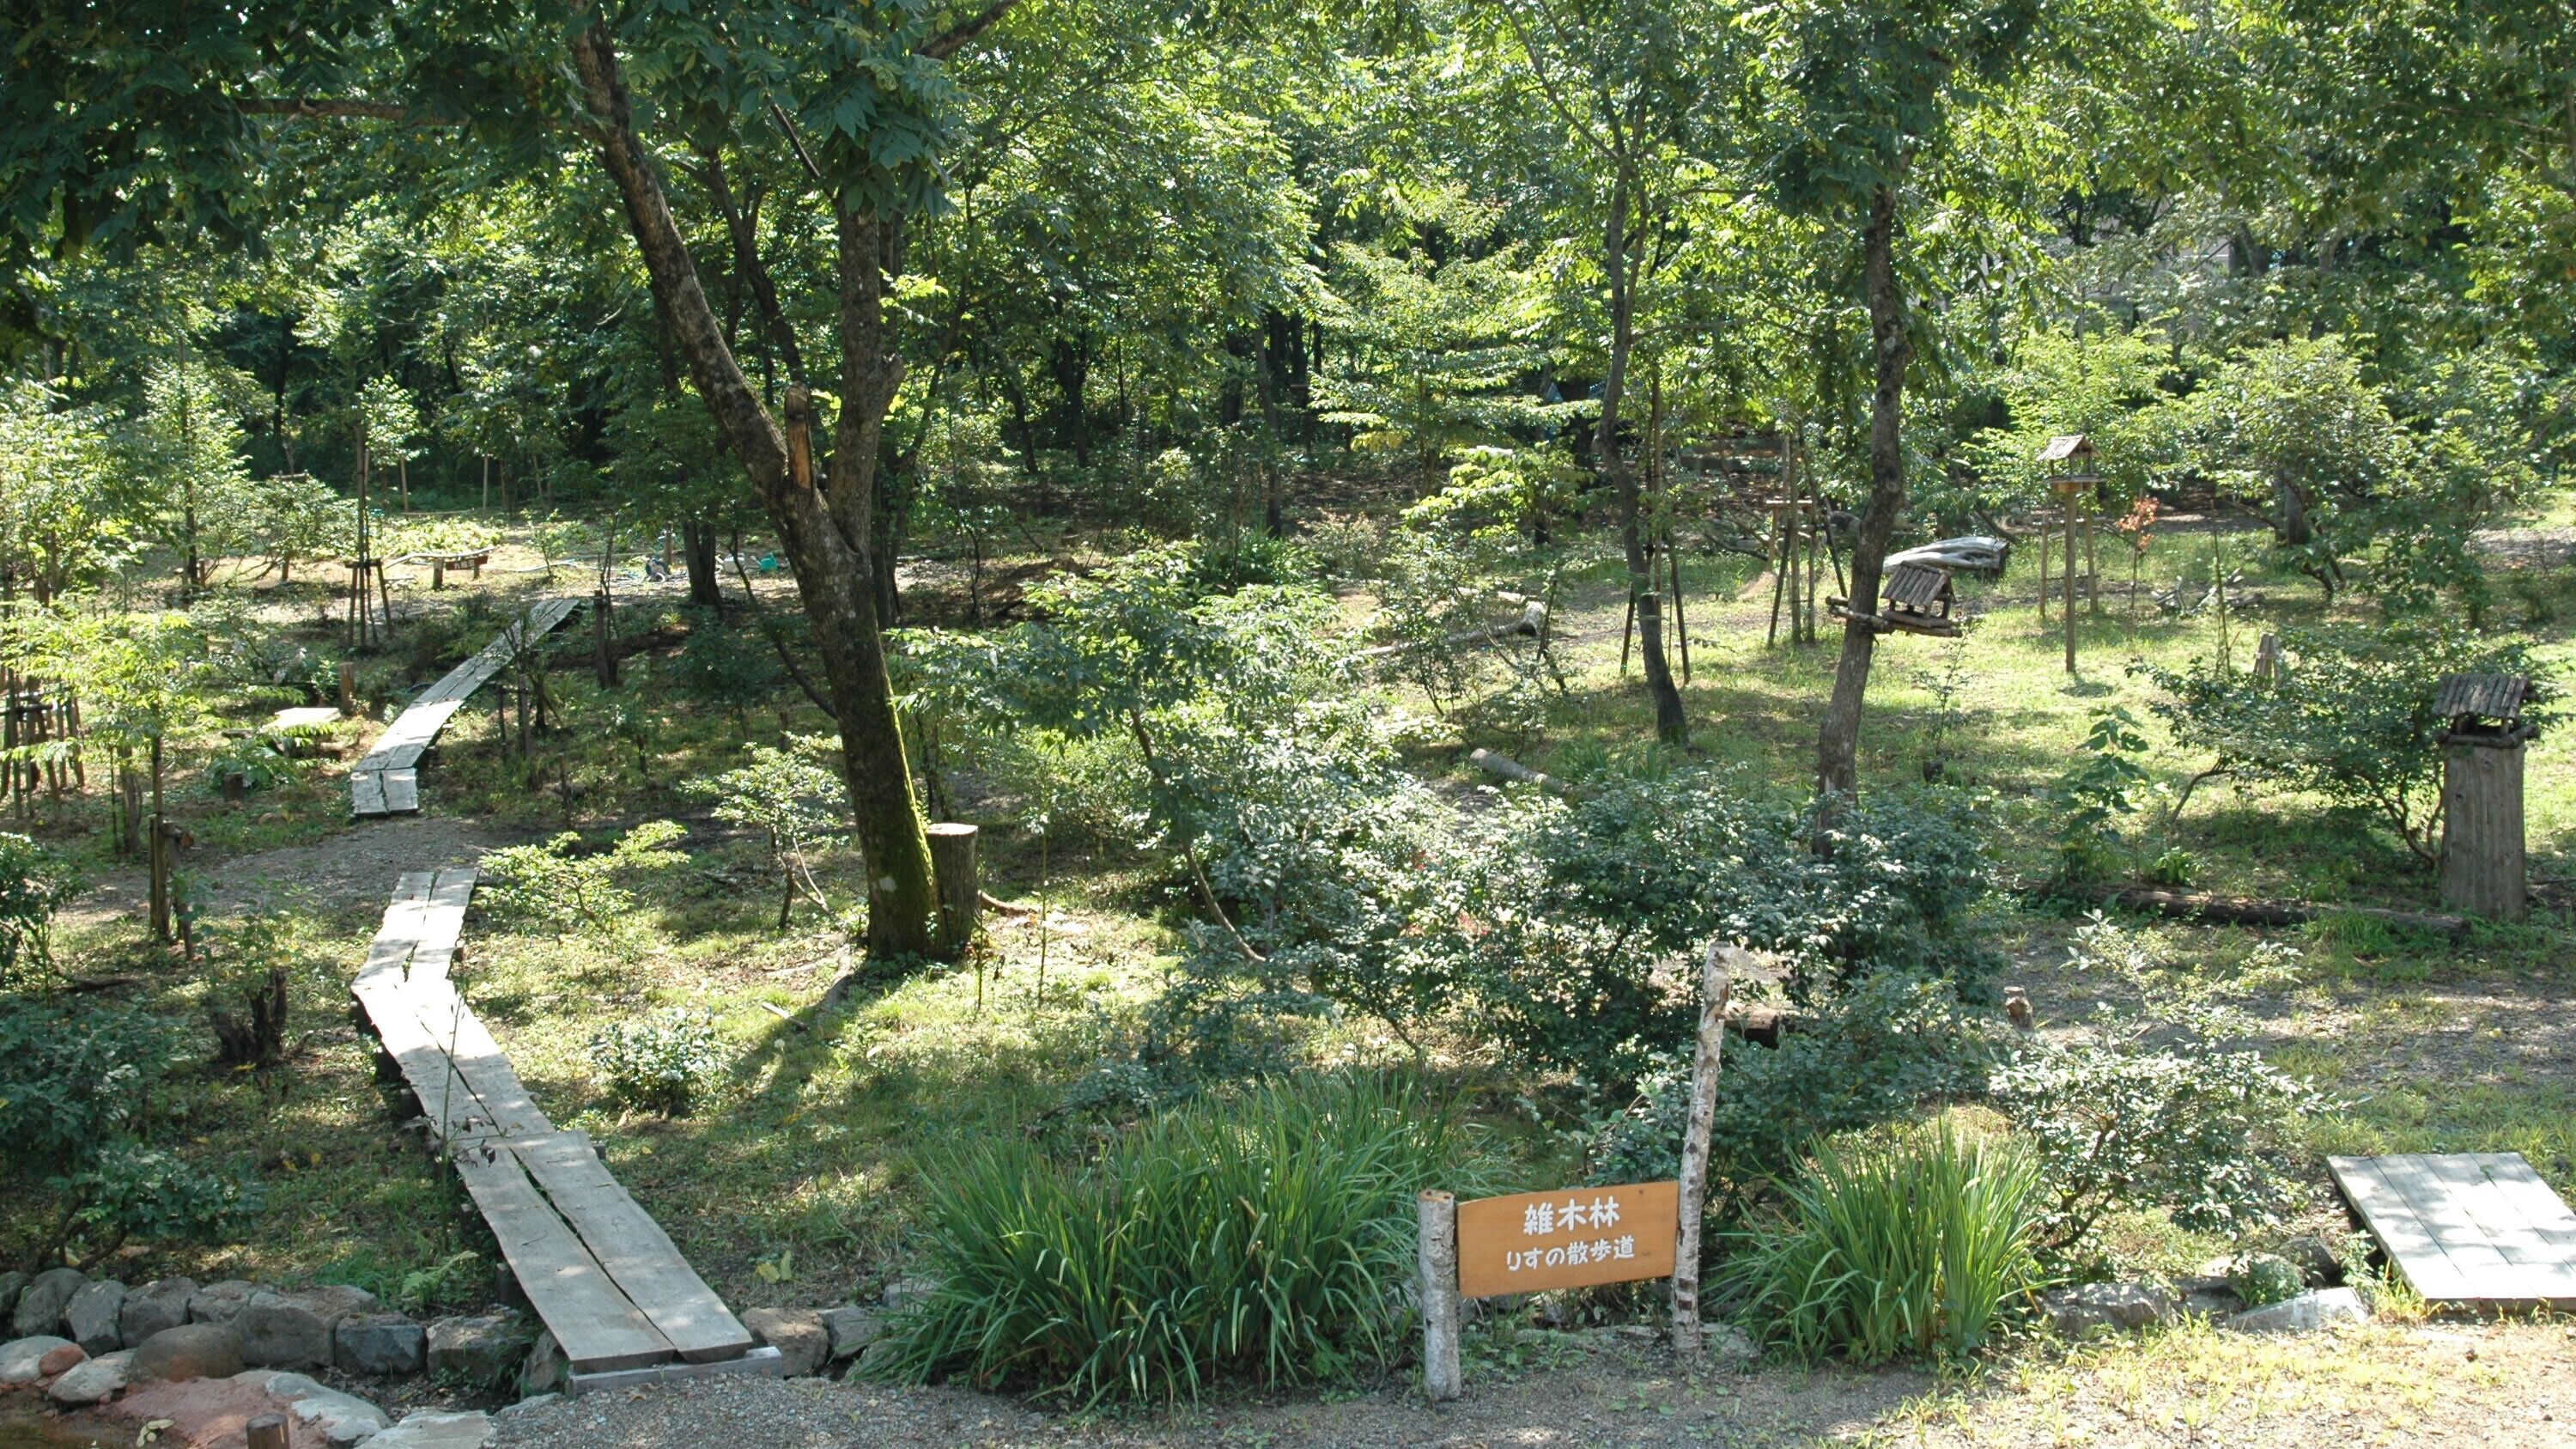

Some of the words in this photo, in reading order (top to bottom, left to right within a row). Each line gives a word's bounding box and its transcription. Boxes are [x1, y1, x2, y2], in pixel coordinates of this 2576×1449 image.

[1523, 1196, 1620, 1235] 雑木林
[1506, 1235, 1635, 1272] りすの散歩道
